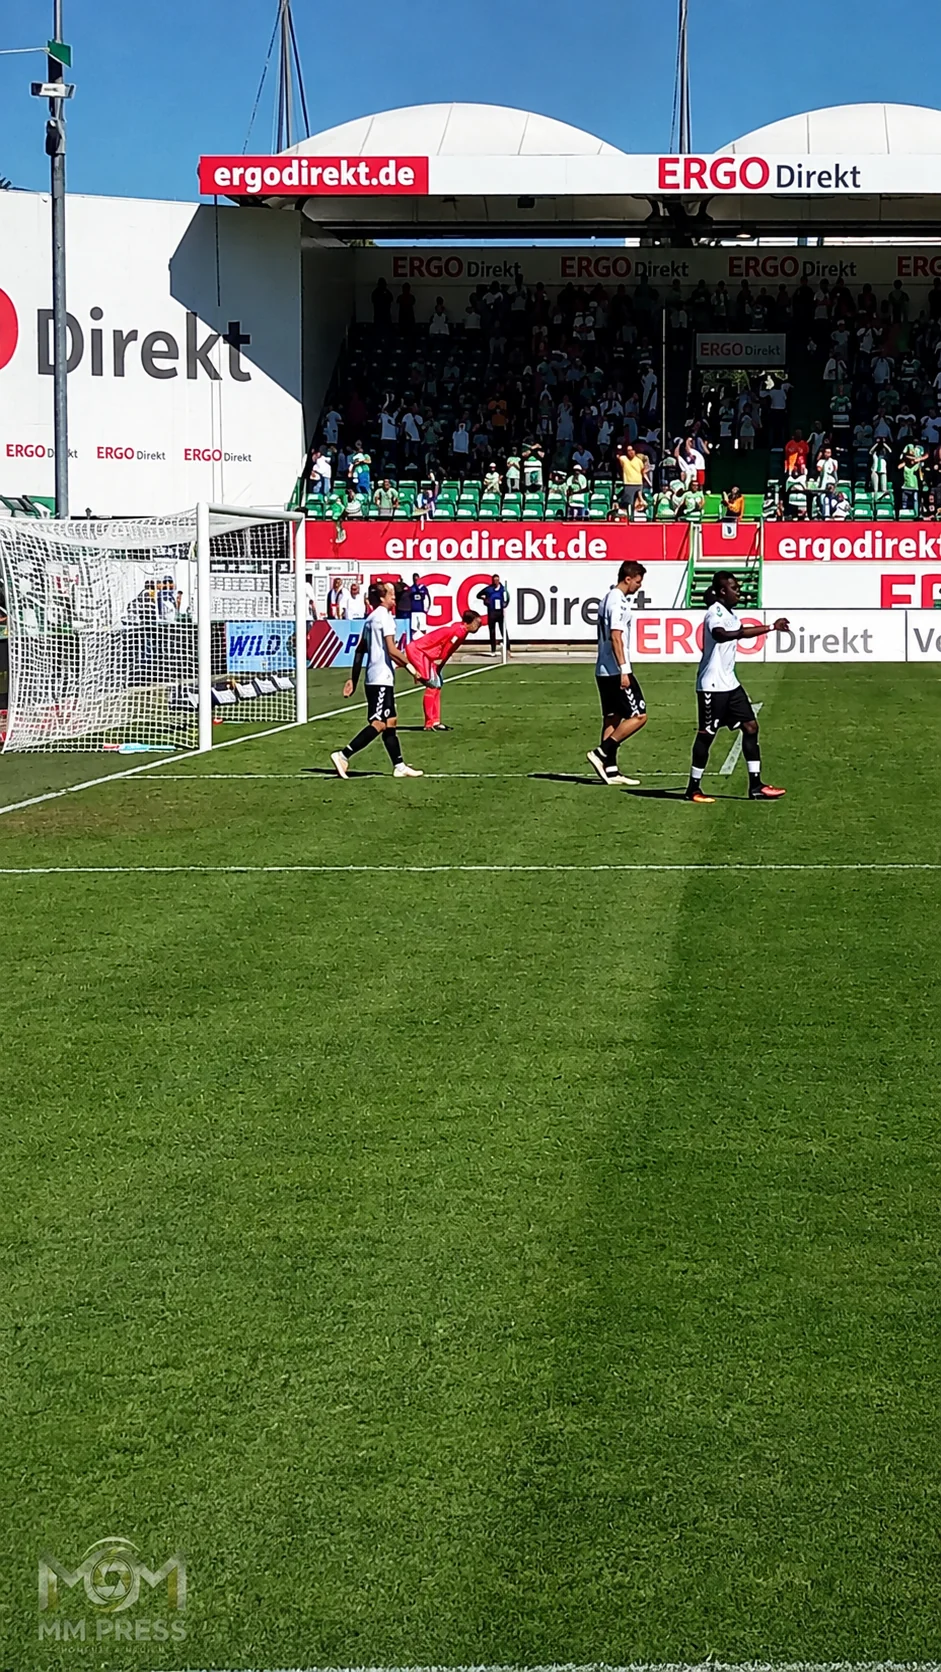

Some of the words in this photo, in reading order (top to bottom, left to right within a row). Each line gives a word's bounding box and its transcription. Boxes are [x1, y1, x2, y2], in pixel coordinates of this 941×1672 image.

[213, 159, 415, 194] ergodirekt.de
[658, 156, 770, 190] ERGO
[776, 163, 861, 188] Direkt
[393, 256, 464, 278] ERGO
[467, 260, 521, 278] Direkt
[561, 256, 632, 278] ERGO
[635, 260, 689, 278] Direkt
[728, 256, 799, 278] ERGO
[802, 260, 857, 278] Direkt
[37, 306, 252, 382] Direkt
[701, 342, 743, 357] ERGO
[745, 345, 781, 356] Direkt
[6, 444, 46, 458] ERGO
[47, 448, 78, 458] Dkt
[97, 446, 134, 460] ERGO
[137, 450, 166, 460] Direkt
[184, 448, 222, 461] ERGO
[224, 452, 252, 462] Direkt
[385, 530, 608, 561] ergodirekt.de
[517, 585, 652, 626] Diret
[229, 634, 281, 658] WILD
[636, 617, 765, 656] ERO
[776, 627, 873, 654] Direkt
[913, 628, 941, 653] V
